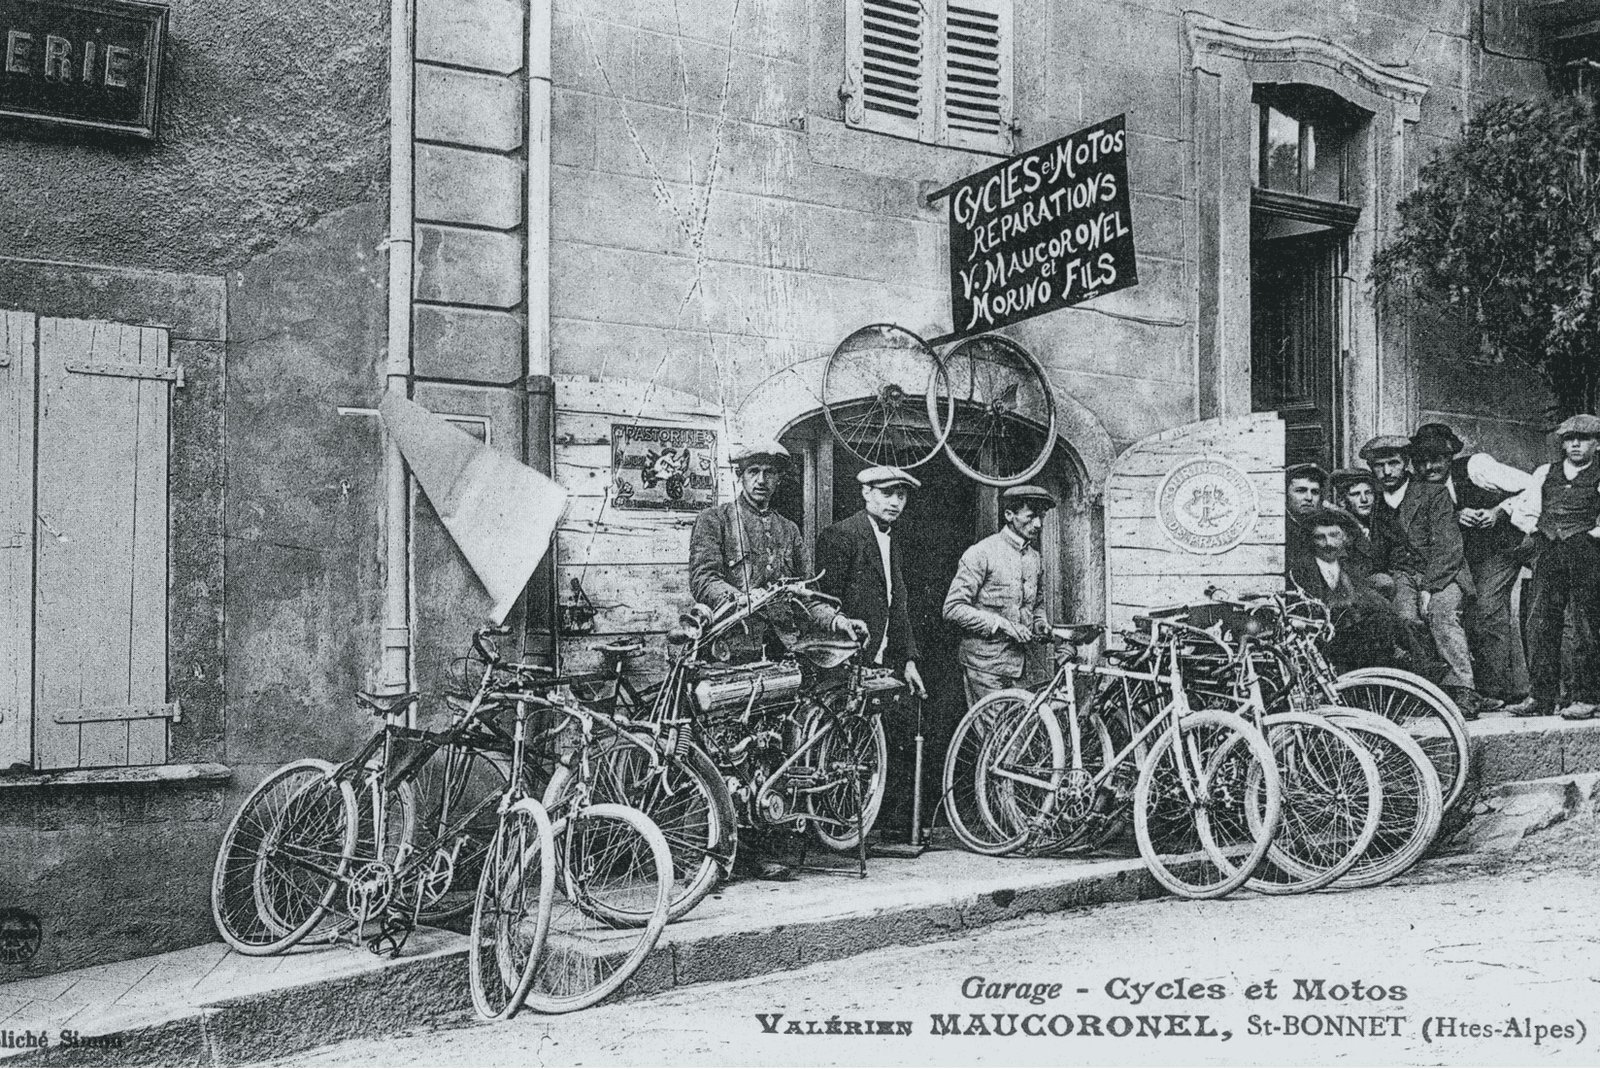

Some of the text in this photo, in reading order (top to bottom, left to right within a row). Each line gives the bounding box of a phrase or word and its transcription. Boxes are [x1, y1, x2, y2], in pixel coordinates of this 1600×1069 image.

[5, 30, 132, 87] ERIE
[954, 156, 1041, 230] CYCLES
[1048, 129, 1125, 183] MOTOS
[968, 172, 1117, 262] REPARATIONS
[966, 252, 1117, 330] MORINO et FILS
[982, 211, 1129, 292] MAUCORONEL
[627, 426, 705, 442] PASTORINE
